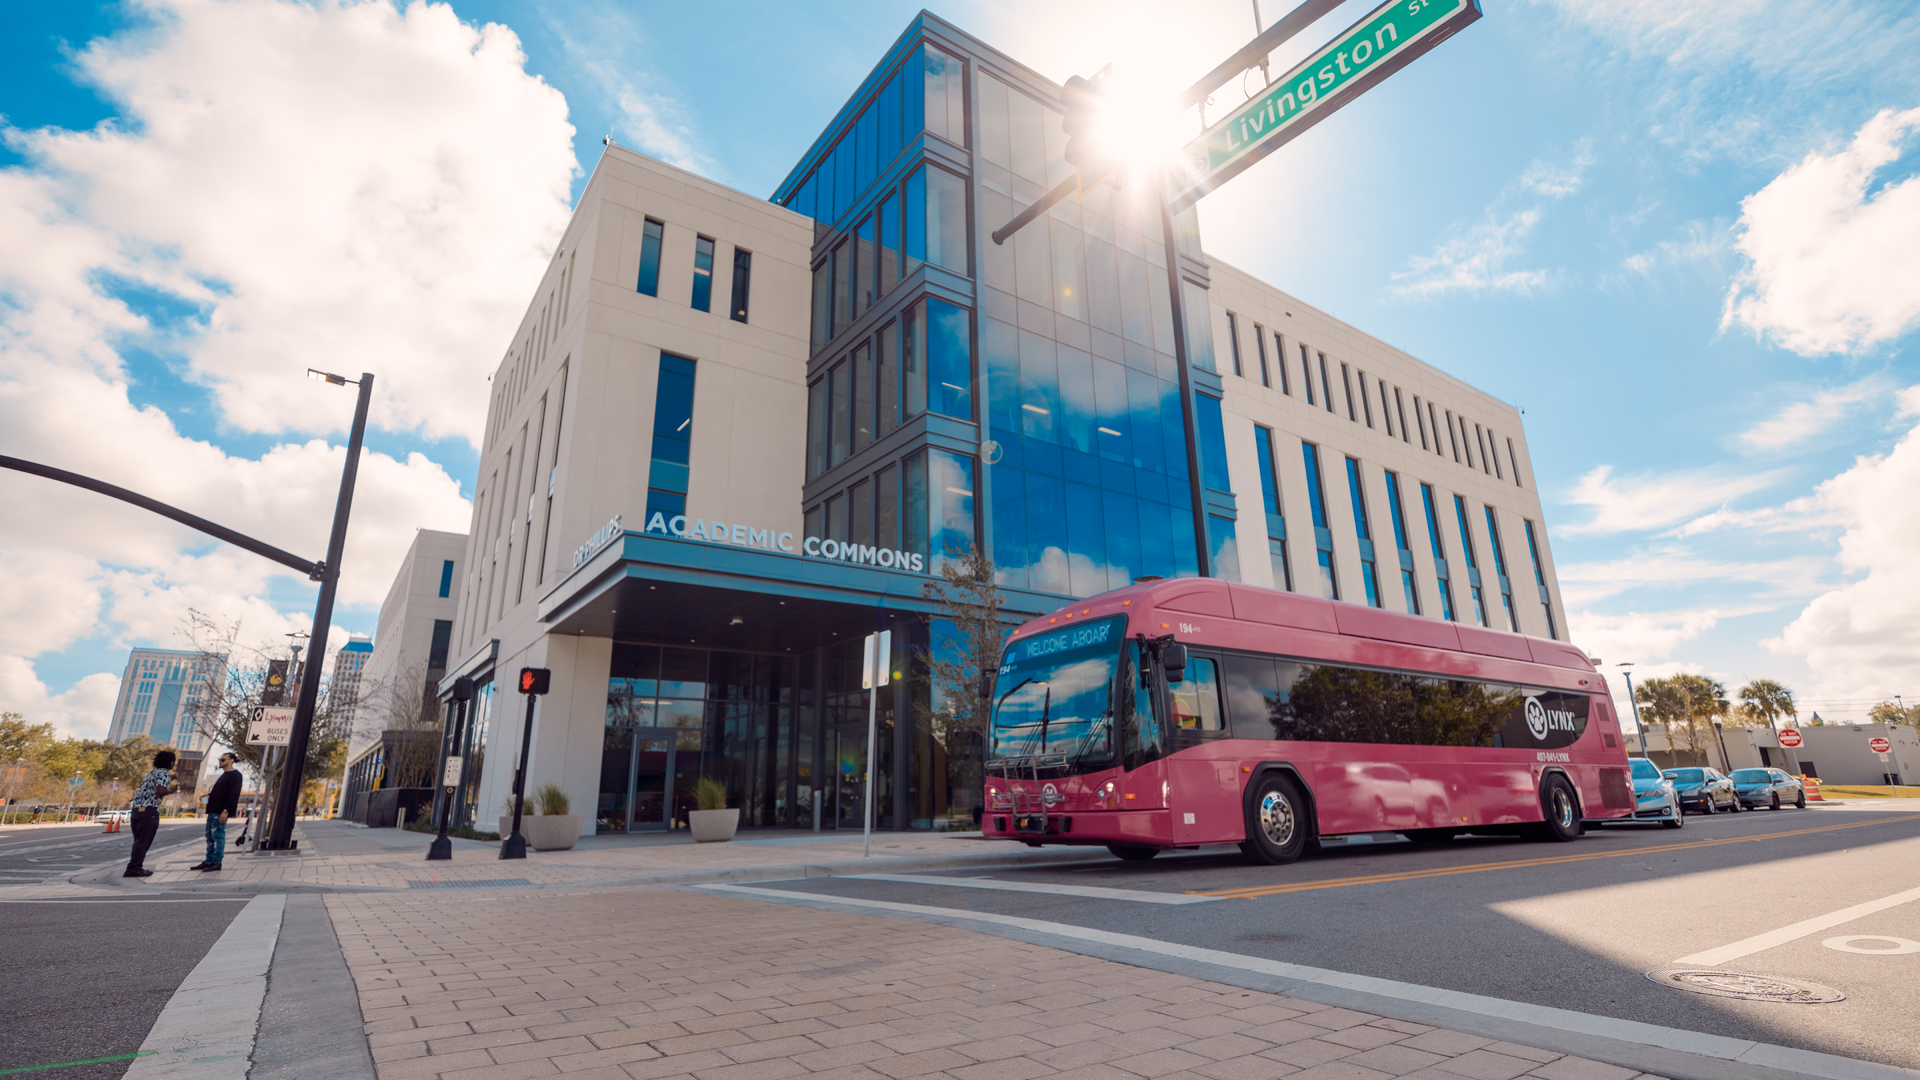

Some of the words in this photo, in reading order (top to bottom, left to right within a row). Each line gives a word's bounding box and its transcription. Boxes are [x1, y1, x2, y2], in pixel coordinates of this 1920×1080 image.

[1224, 22, 1398, 152] Livingston
[645, 511, 794, 552] ACADEMIC
[803, 536, 923, 572] COMMONS
[1026, 635, 1068, 657] WELCOME
[1547, 709, 1575, 731] LYNX
